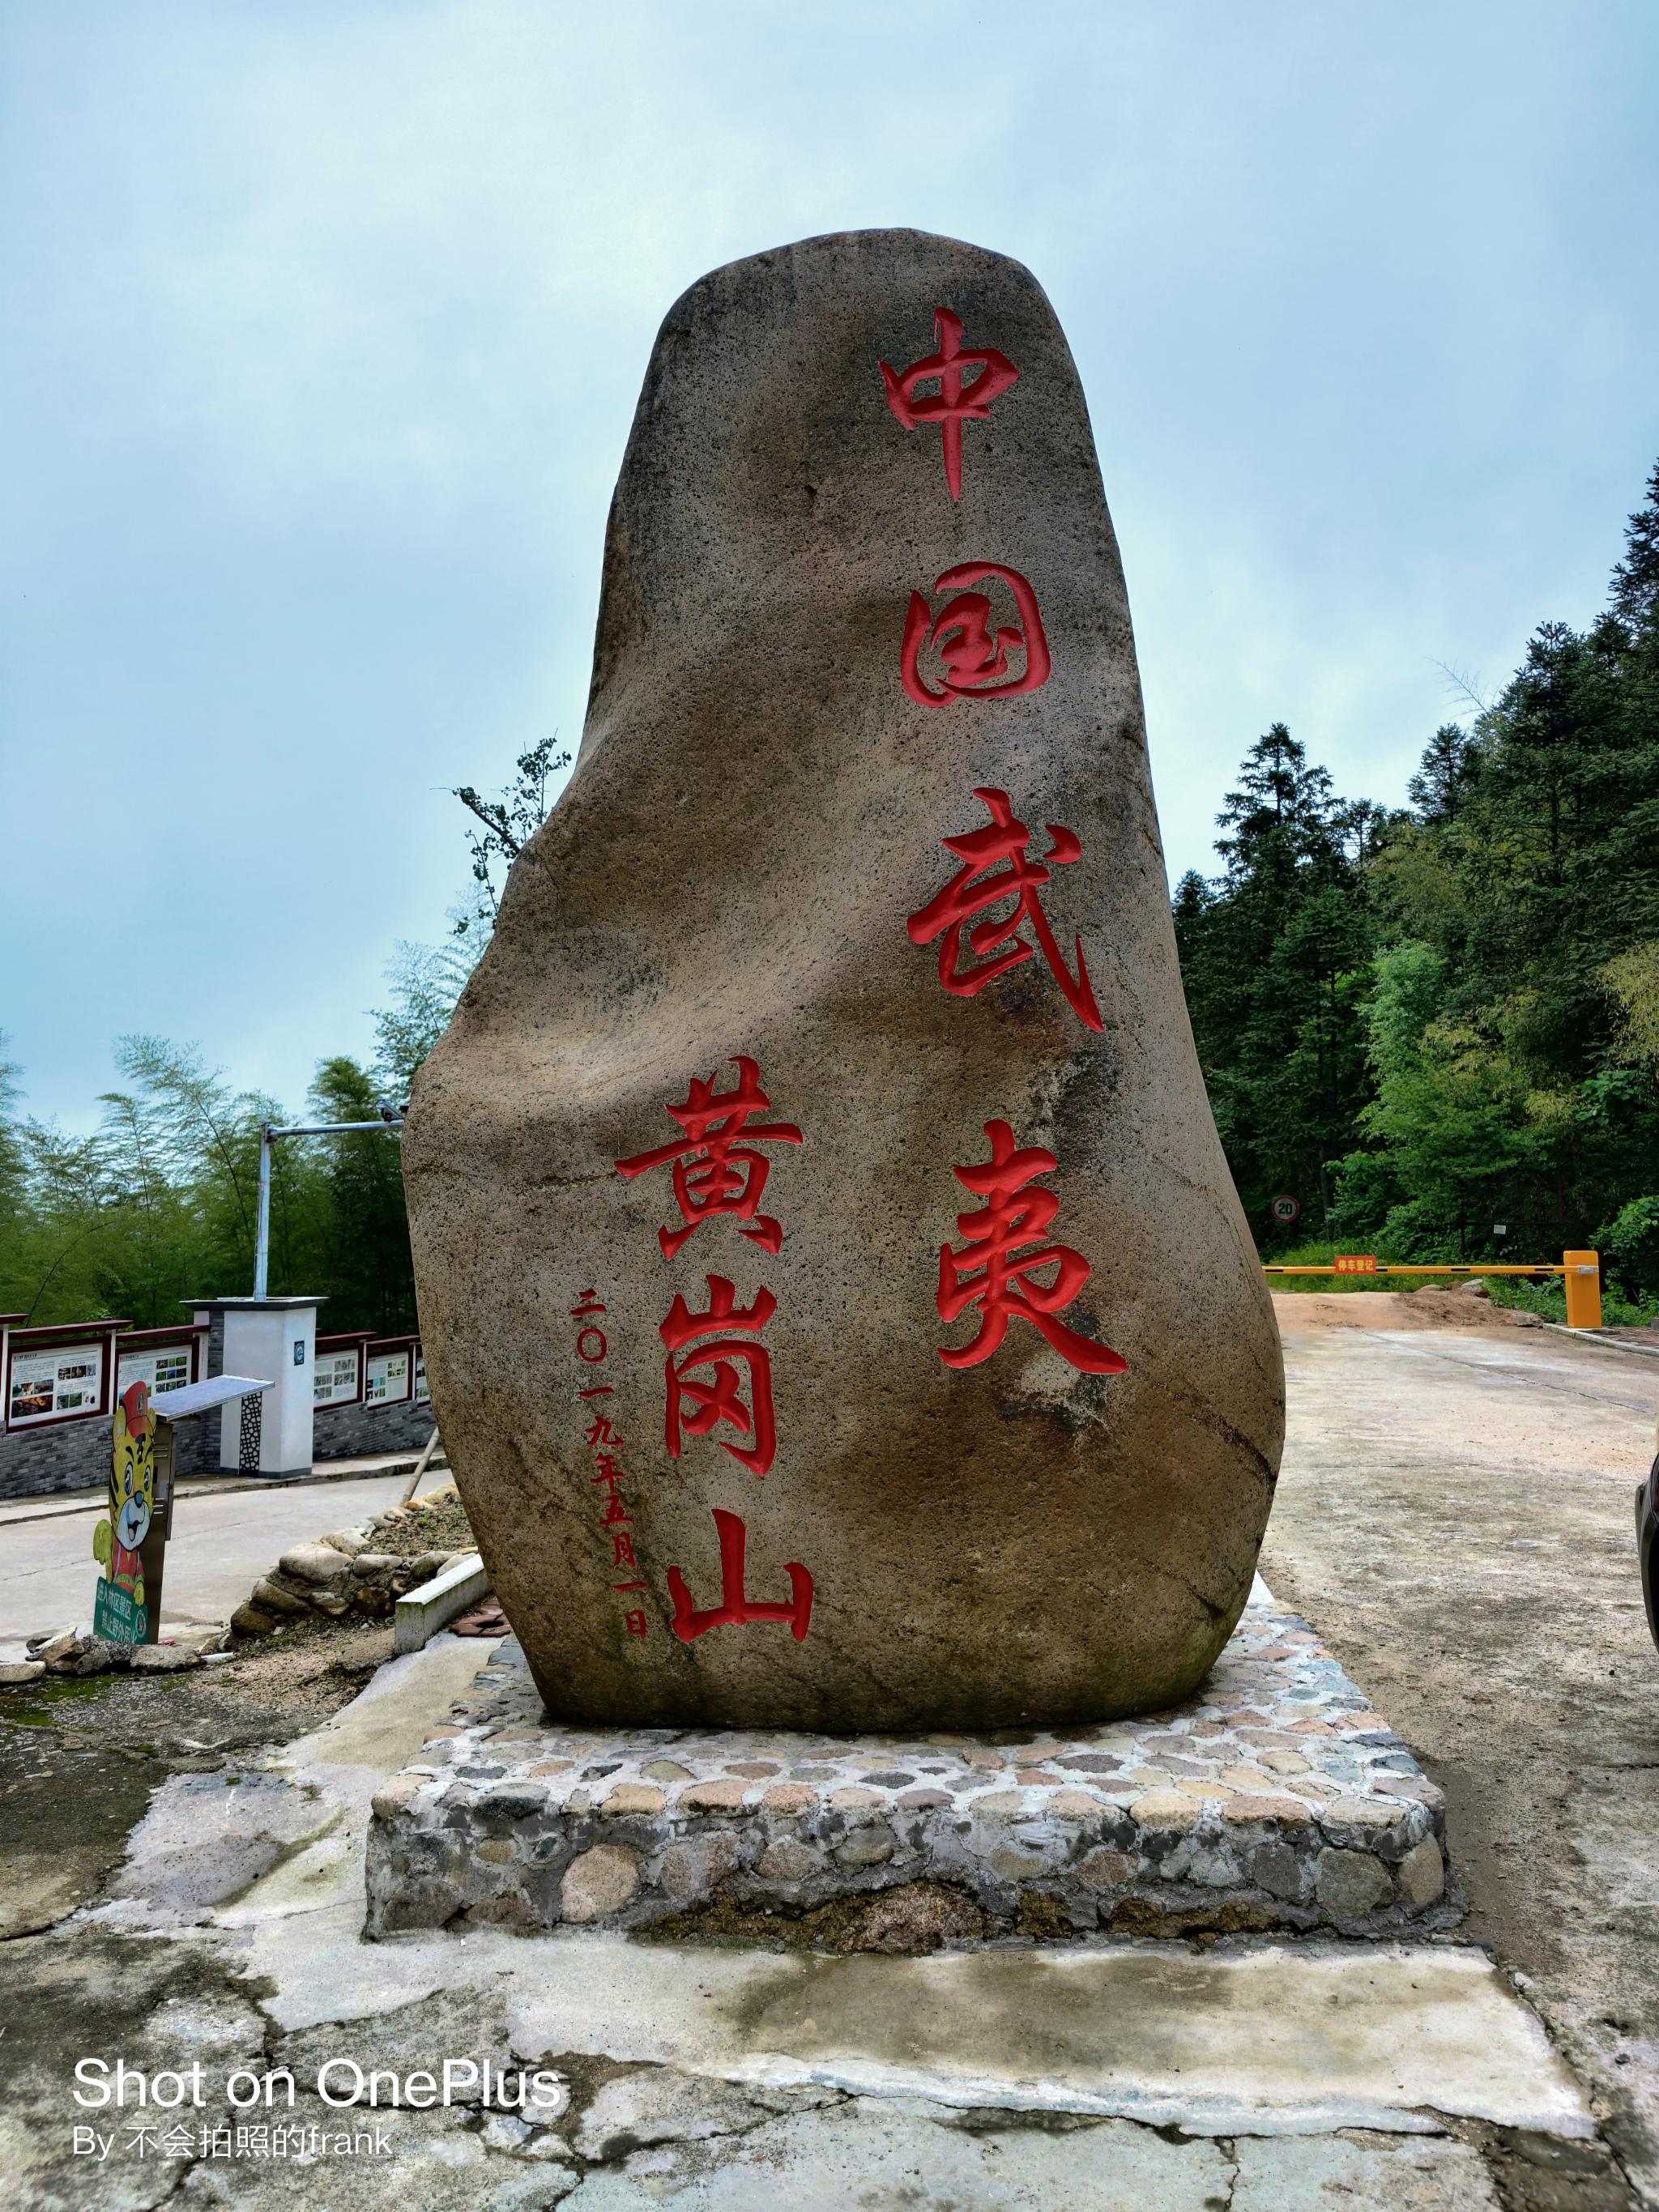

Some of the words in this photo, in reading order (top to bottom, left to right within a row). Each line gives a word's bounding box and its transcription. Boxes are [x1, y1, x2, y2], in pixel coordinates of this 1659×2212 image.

[878, 310, 1128, 1375] 中国武夷
[1278, 1203, 1292, 1214] 20
[1338, 1259, 1374, 1271] 停车登记
[613, 1056, 815, 1643] 黄岗山
[97, 1583, 131, 1620] 进入林区景区
